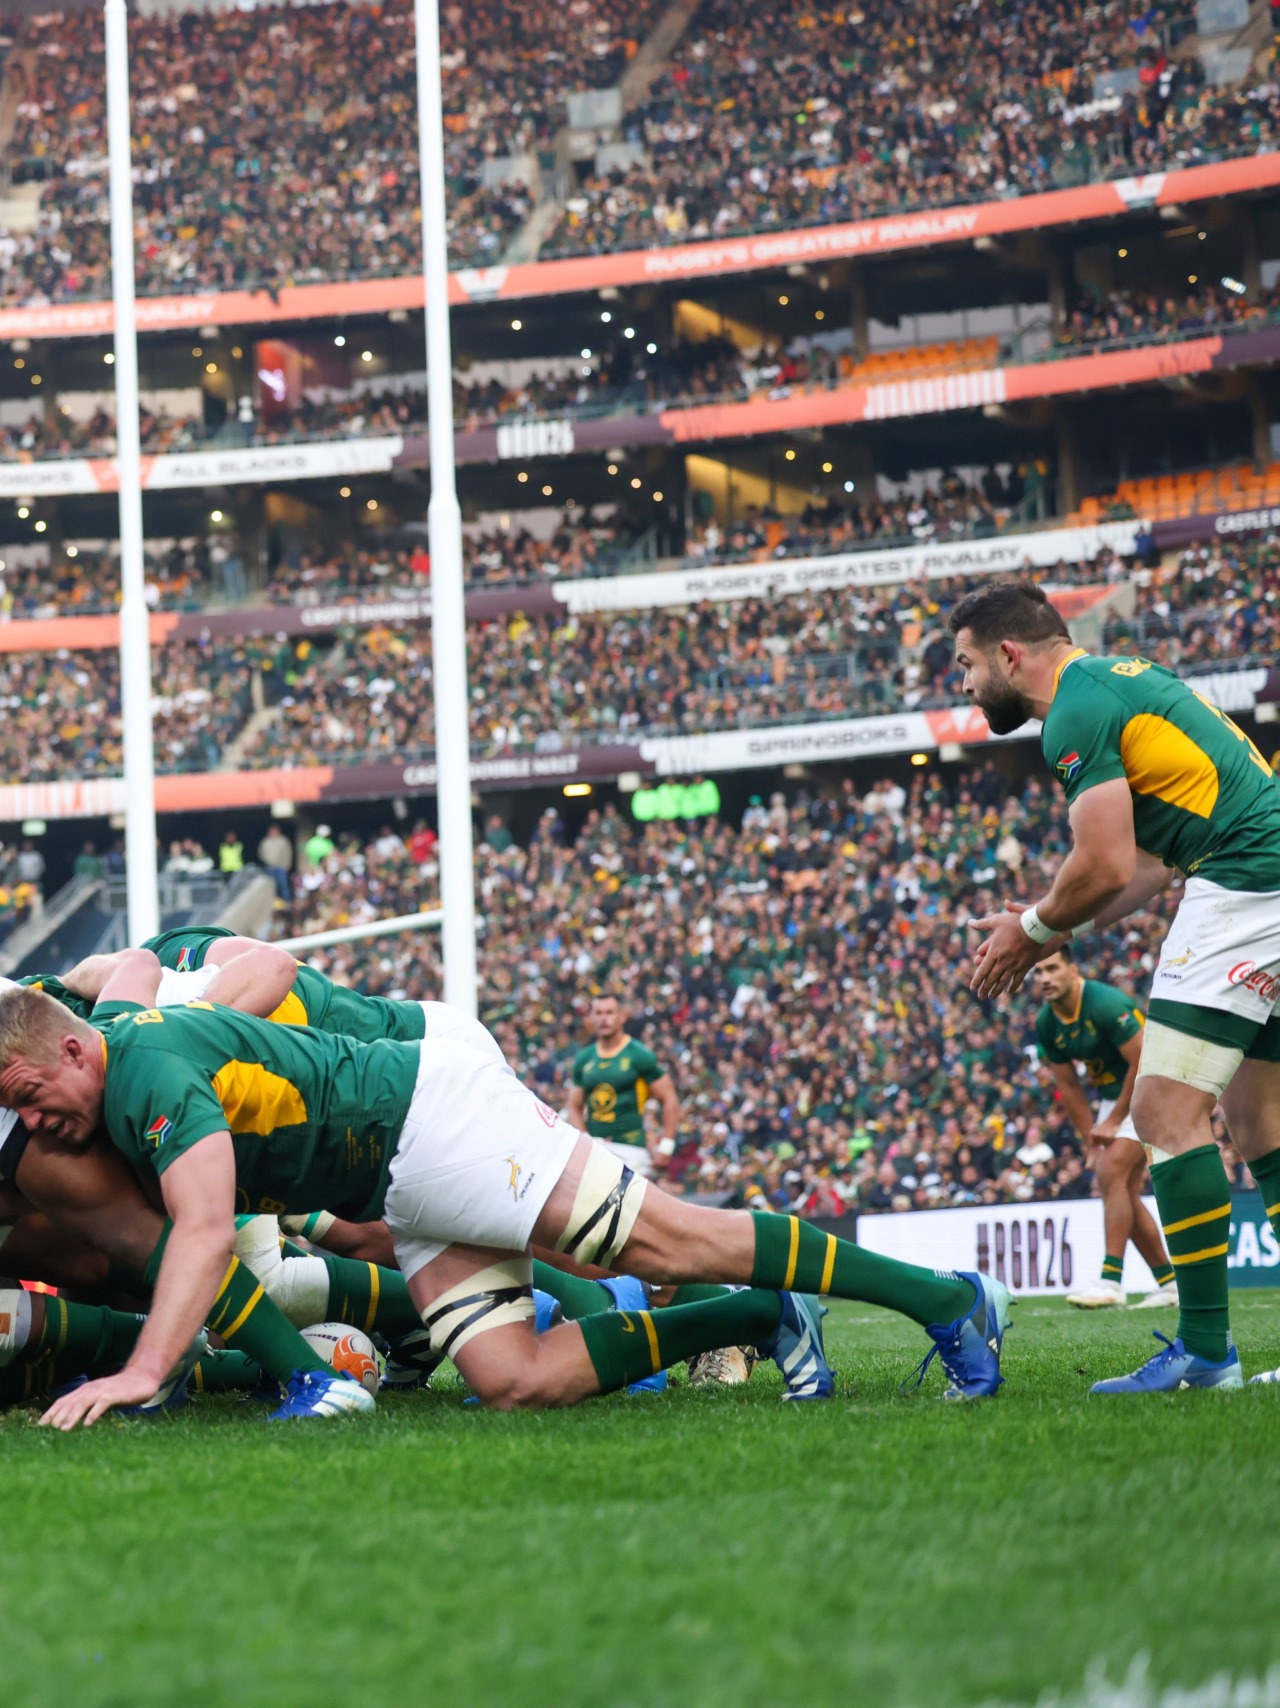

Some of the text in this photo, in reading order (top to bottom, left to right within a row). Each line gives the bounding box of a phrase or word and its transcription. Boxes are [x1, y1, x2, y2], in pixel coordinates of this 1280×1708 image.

[752, 226, 874, 261] GREATEST
[879, 214, 979, 243] RIVALRY
[795, 557, 917, 586] GREATEST
[747, 723, 908, 757] SPRINGBOKS
